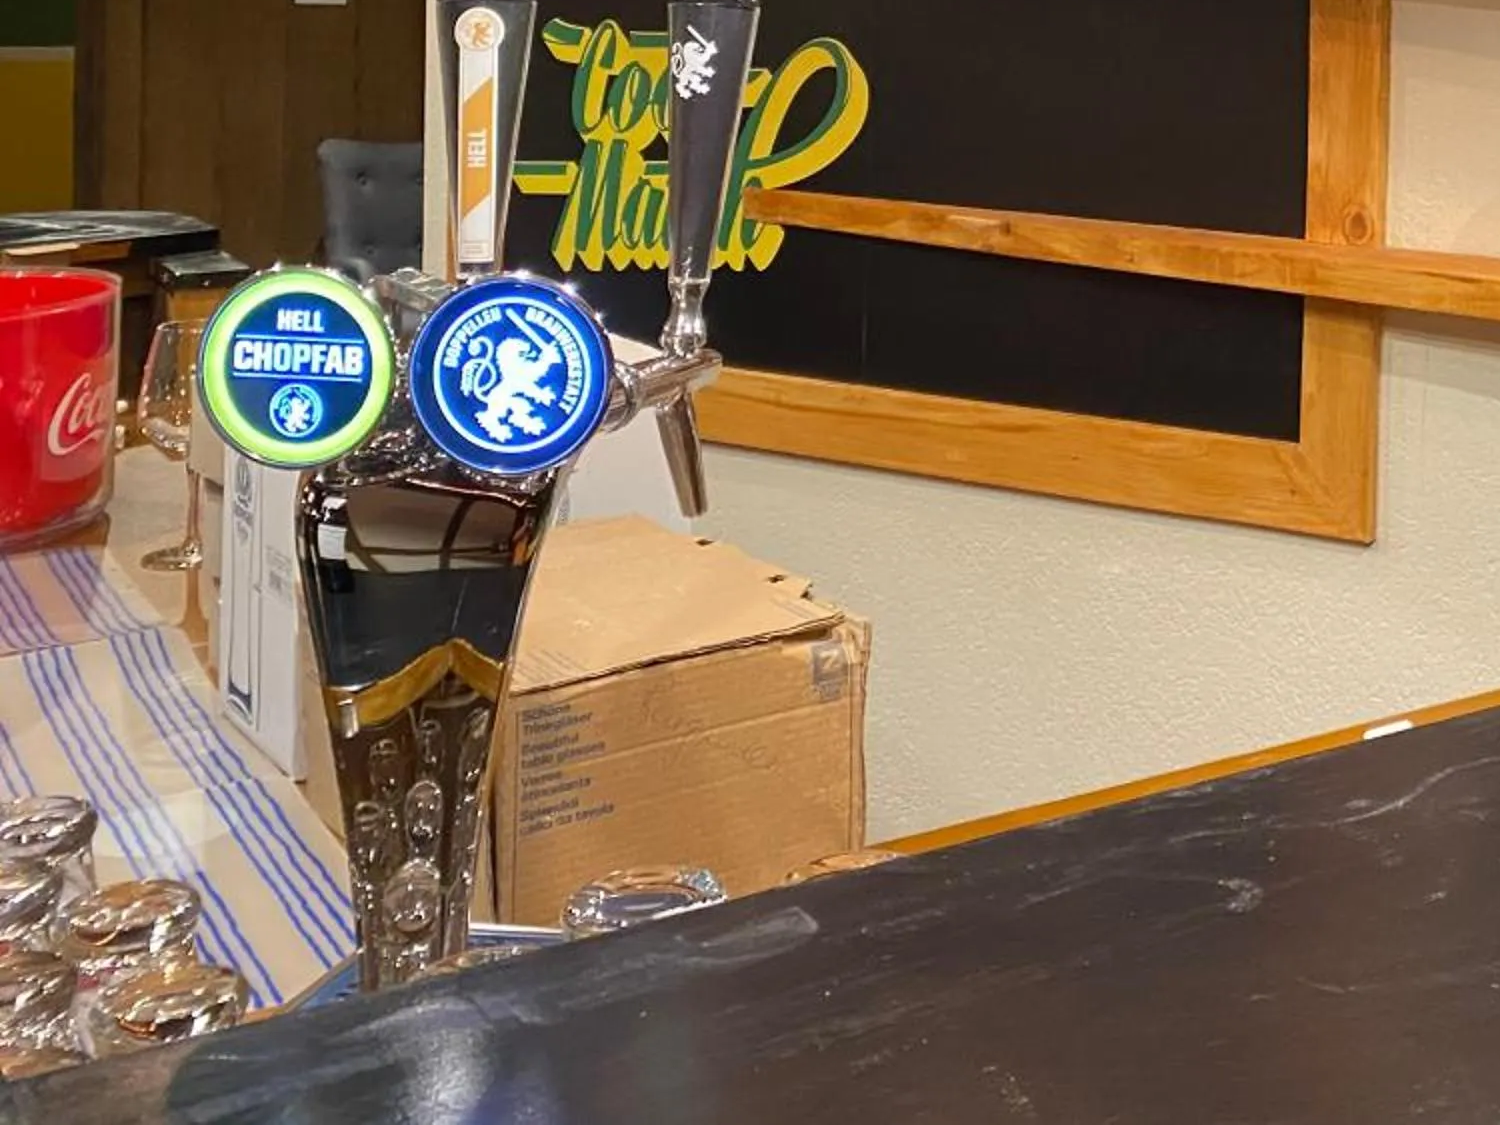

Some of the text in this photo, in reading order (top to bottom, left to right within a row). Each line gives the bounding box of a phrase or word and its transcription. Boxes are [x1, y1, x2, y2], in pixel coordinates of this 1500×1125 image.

[467, 127, 488, 169] HELL
[277, 308, 325, 333] HELL
[233, 340, 364, 376] CHOPFAB
